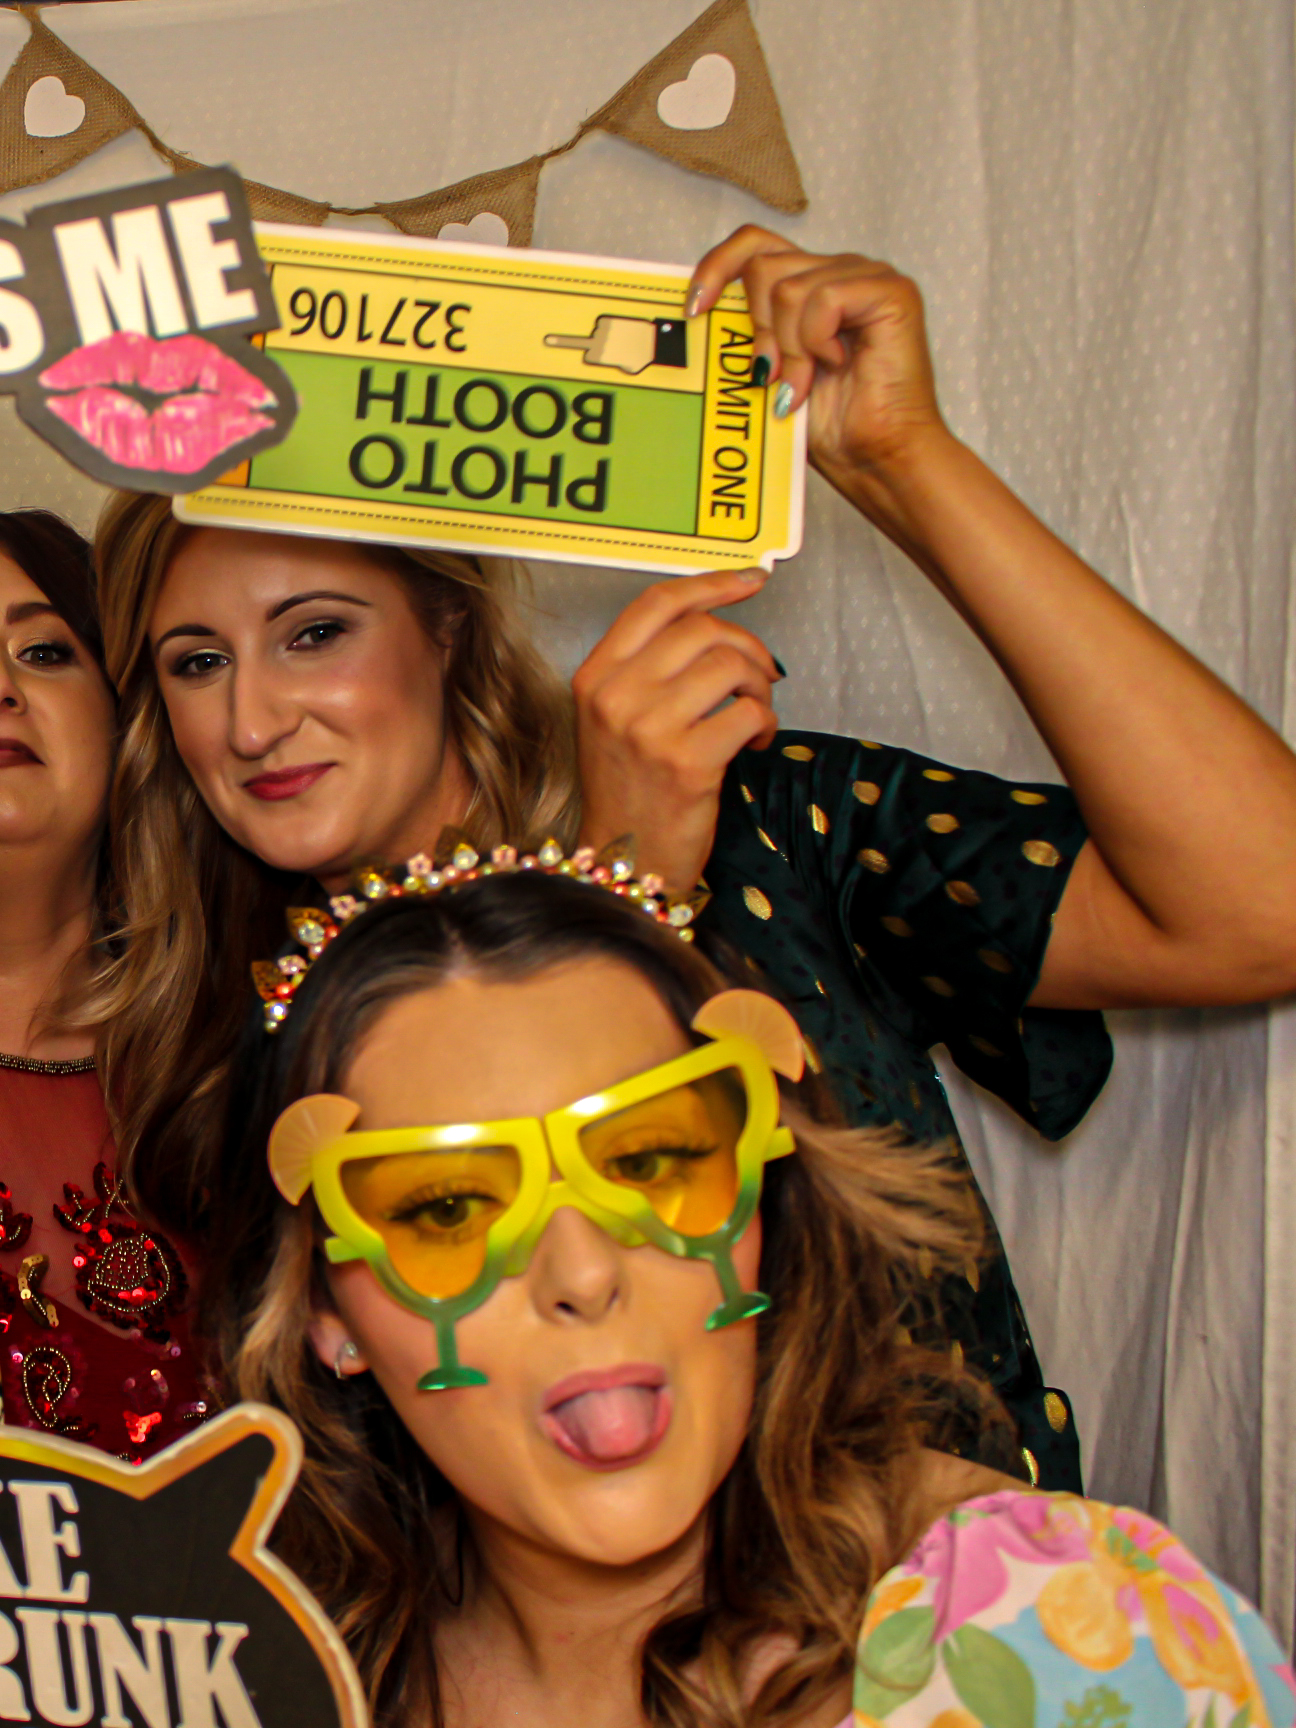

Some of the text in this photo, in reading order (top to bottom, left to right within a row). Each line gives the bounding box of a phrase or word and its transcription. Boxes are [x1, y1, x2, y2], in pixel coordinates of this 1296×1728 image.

[54, 191, 259, 347] ME
[289, 287, 472, 353] 327106
[354, 366, 616, 446] BOOTH
[710, 327, 754, 520] ADMIT ONE
[349, 434, 612, 513] PHOTO
